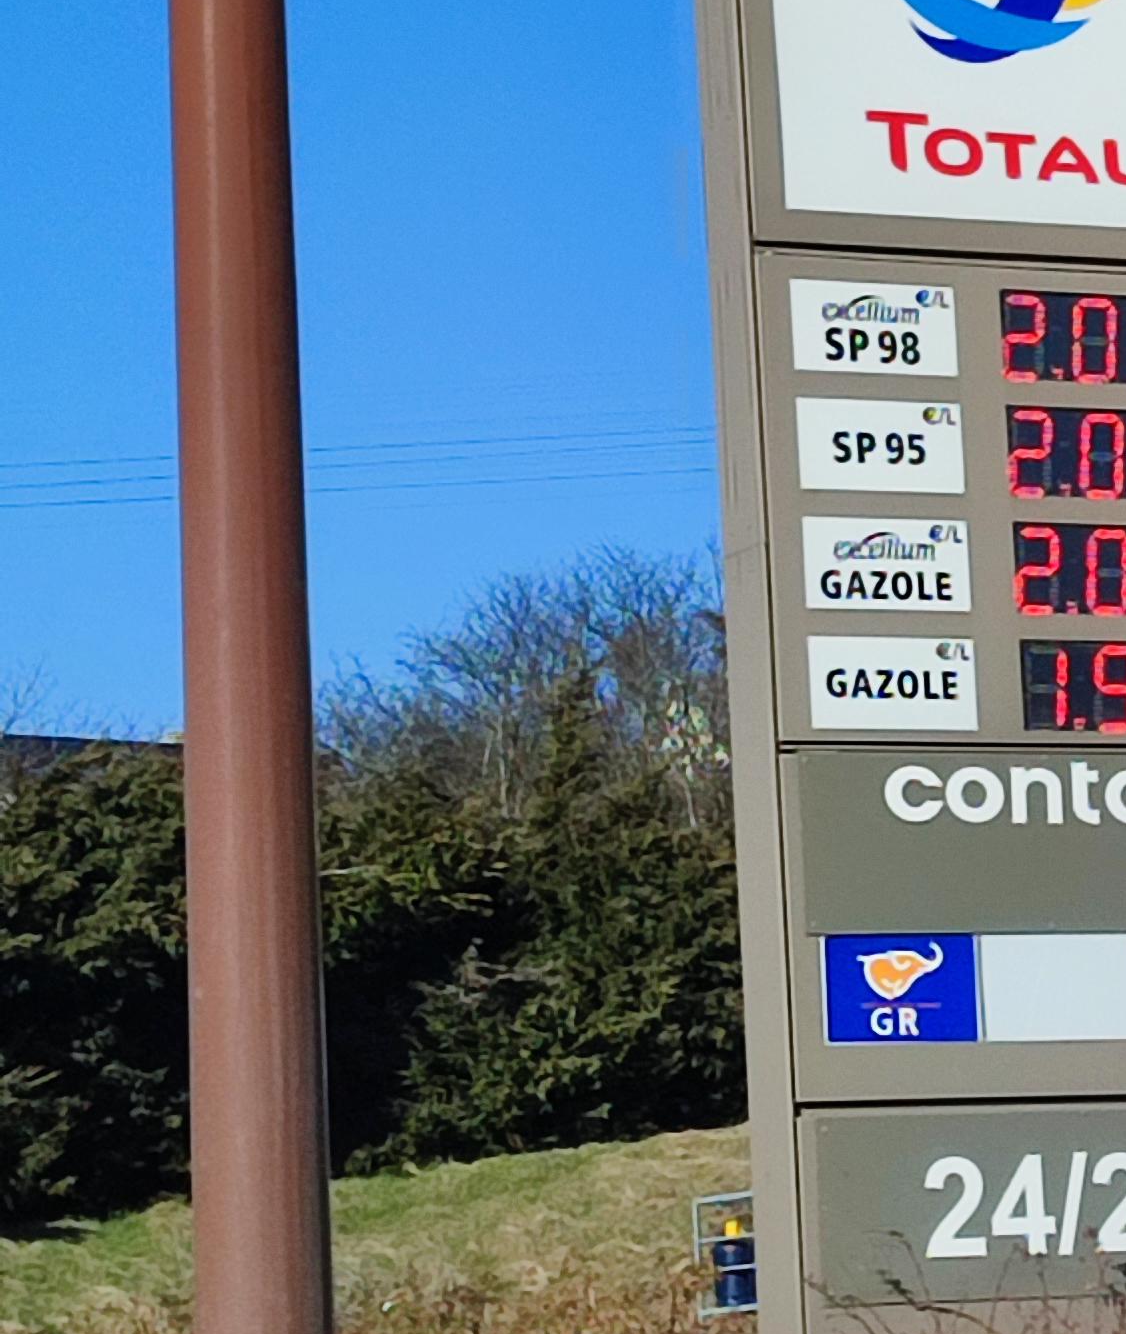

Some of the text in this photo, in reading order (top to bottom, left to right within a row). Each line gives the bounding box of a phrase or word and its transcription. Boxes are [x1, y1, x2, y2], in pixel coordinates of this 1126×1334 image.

[820, 569, 953, 601] GAZOLE
[826, 668, 959, 700] GAZOLE
[870, 1007, 919, 1037] GR
